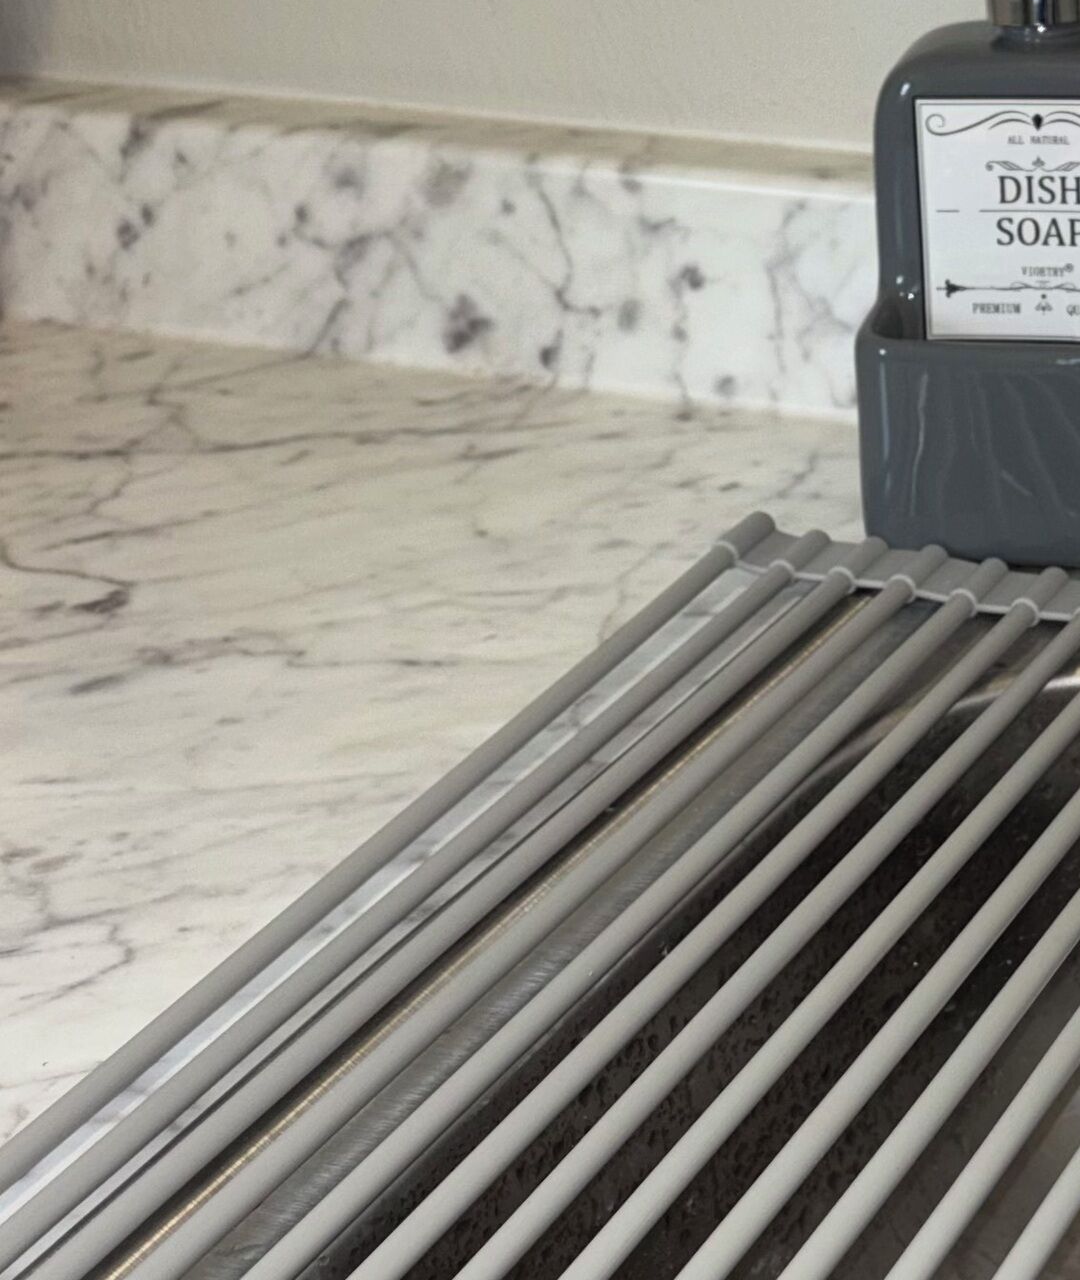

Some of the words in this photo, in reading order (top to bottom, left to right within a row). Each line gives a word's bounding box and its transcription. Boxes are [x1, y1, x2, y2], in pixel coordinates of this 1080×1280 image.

[1007, 135, 1025, 145] ALL
[1030, 135, 1071, 146] NATURAL
[972, 302, 1022, 315] PREMIUM
